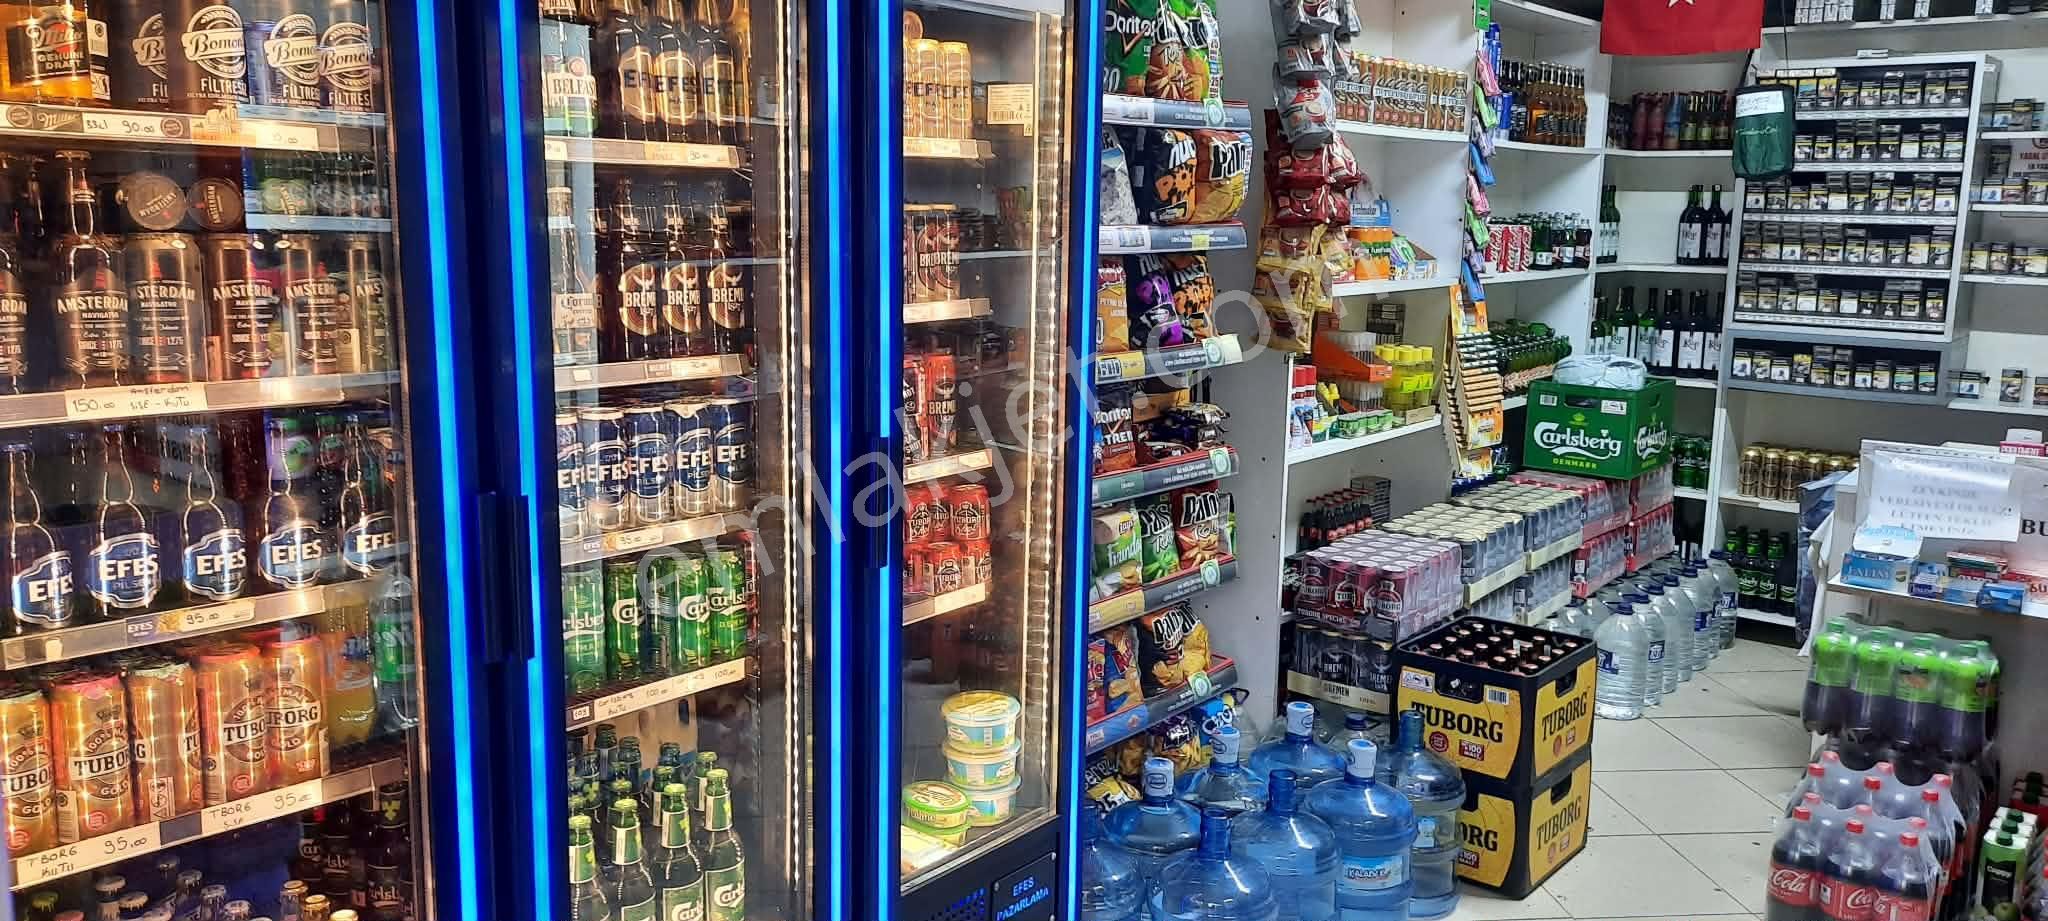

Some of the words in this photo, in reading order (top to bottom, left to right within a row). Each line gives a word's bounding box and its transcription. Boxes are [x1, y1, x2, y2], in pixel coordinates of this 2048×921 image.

[1533, 421, 1622, 459] Carlsberg
[99, 554, 158, 581] EFES
[197, 548, 246, 575] EFES
[271, 541, 322, 565] EFES
[1411, 701, 1503, 743] TUBORG
[1542, 692, 1588, 741] TUBORG
[1536, 796, 1582, 850] TUBORG
[1012, 876, 1034, 897] EFES
